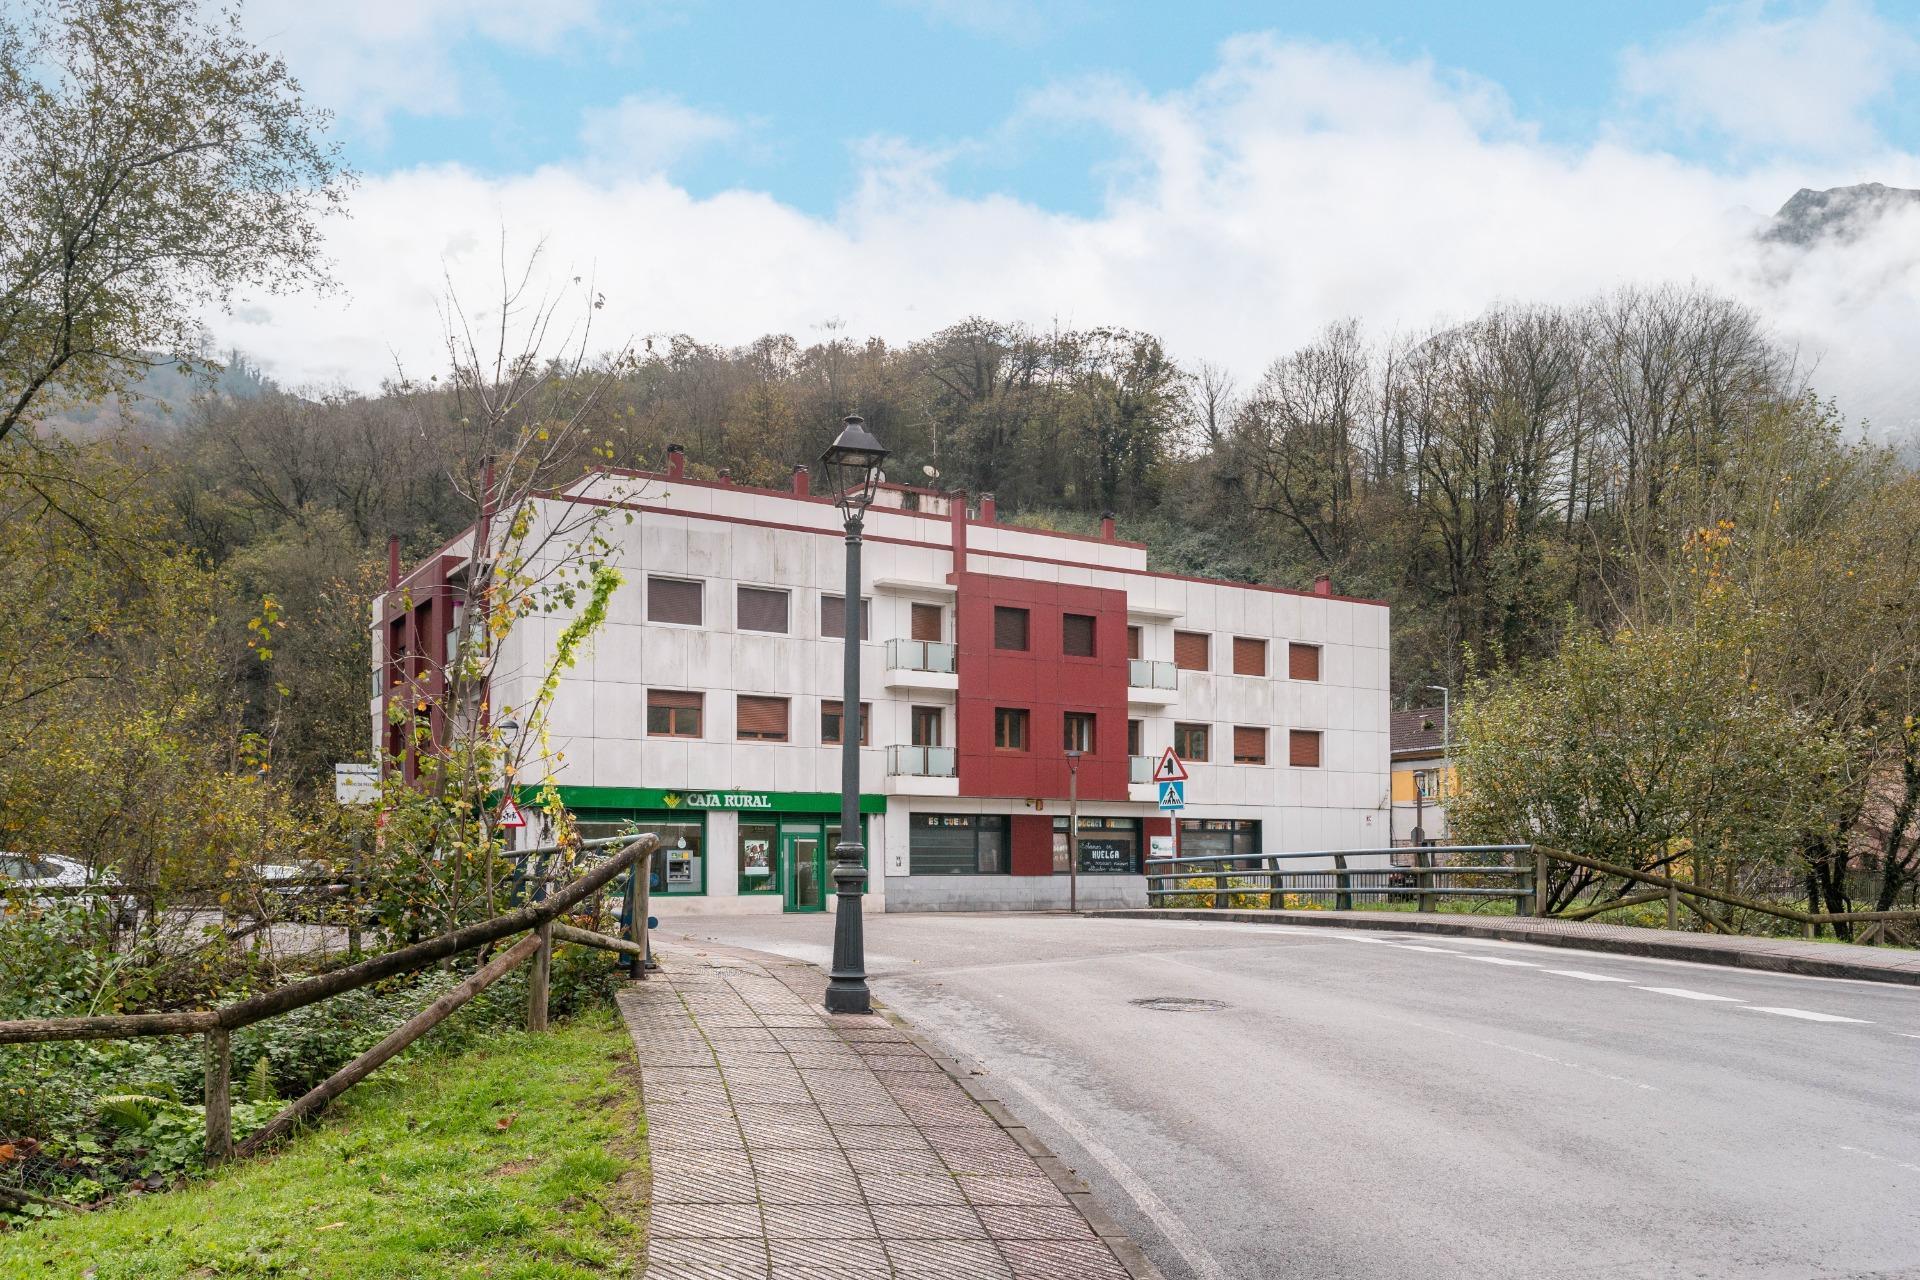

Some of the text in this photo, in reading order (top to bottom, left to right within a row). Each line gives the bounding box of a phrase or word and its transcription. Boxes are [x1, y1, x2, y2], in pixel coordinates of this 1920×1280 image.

[687, 794, 771, 807] CAJA RURAL
[1092, 850, 1120, 859] HUELGA
